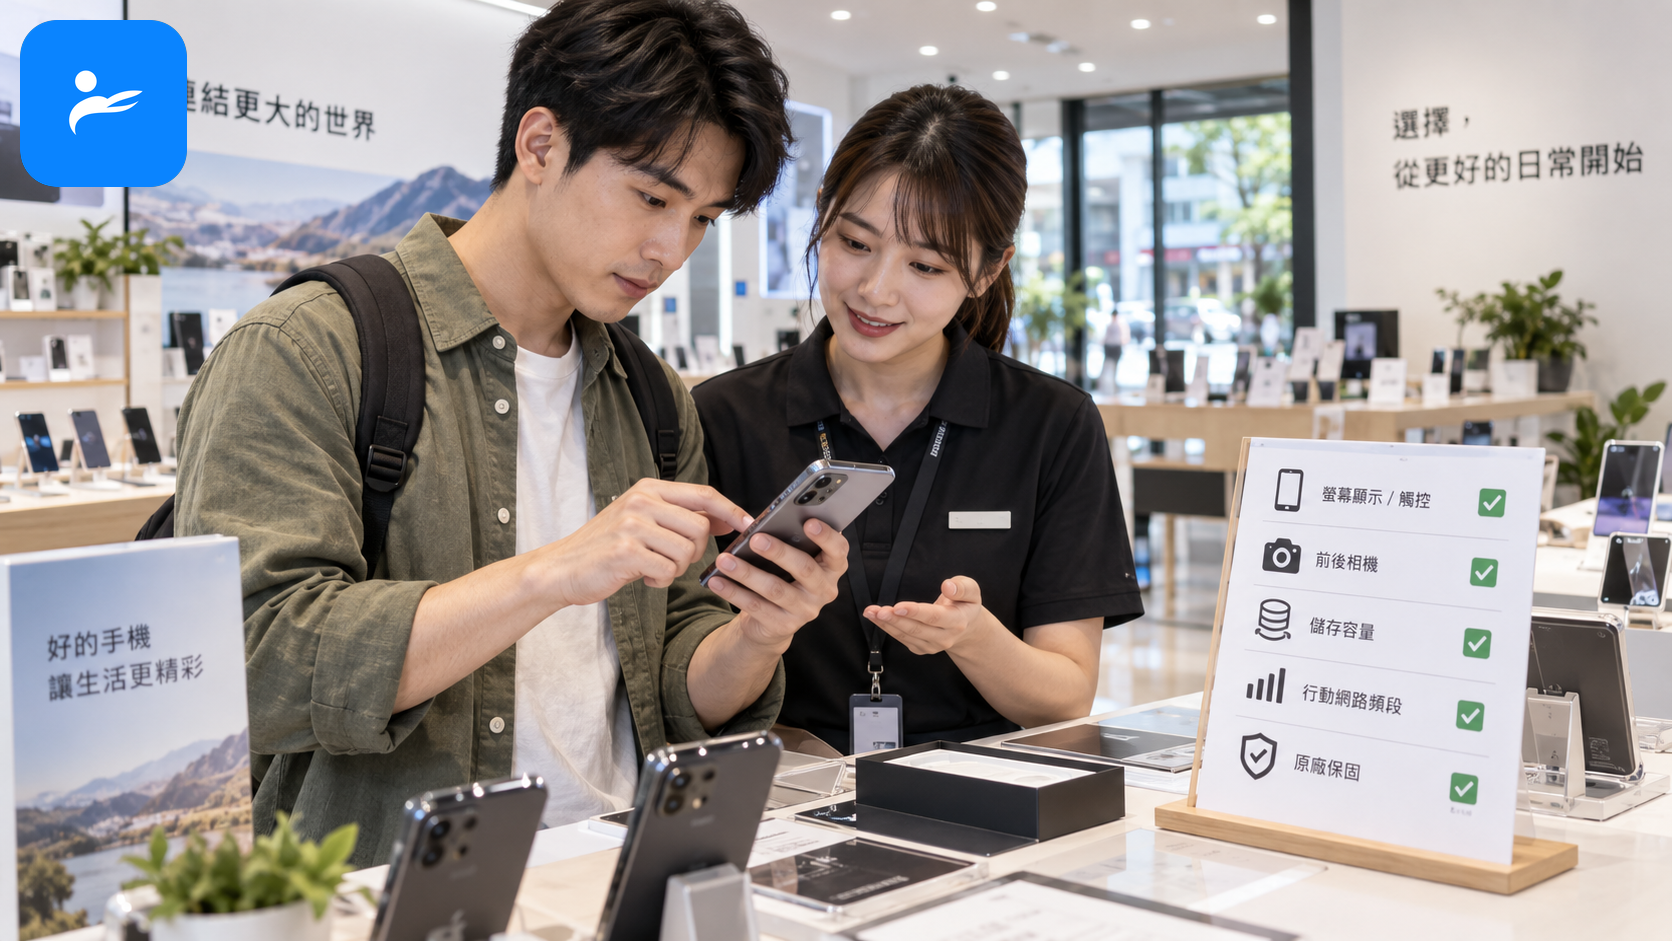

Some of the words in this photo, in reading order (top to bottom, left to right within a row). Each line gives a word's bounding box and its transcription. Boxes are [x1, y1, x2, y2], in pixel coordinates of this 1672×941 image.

[1393, 106, 1470, 140] 選擇，
[1394, 141, 1644, 189] 從更好的日常開始
[1322, 486, 1382, 505] 螢幕顯示
[1398, 491, 1431, 509] 觸控
[1315, 551, 1378, 573] 前後相機
[47, 623, 151, 662] 好的手機
[1310, 617, 1375, 641] 儲存容量
[47, 653, 204, 702] 讓生活更精彩
[1302, 684, 1402, 715] 行動網路頻段
[1294, 754, 1361, 782] 原廠保固
